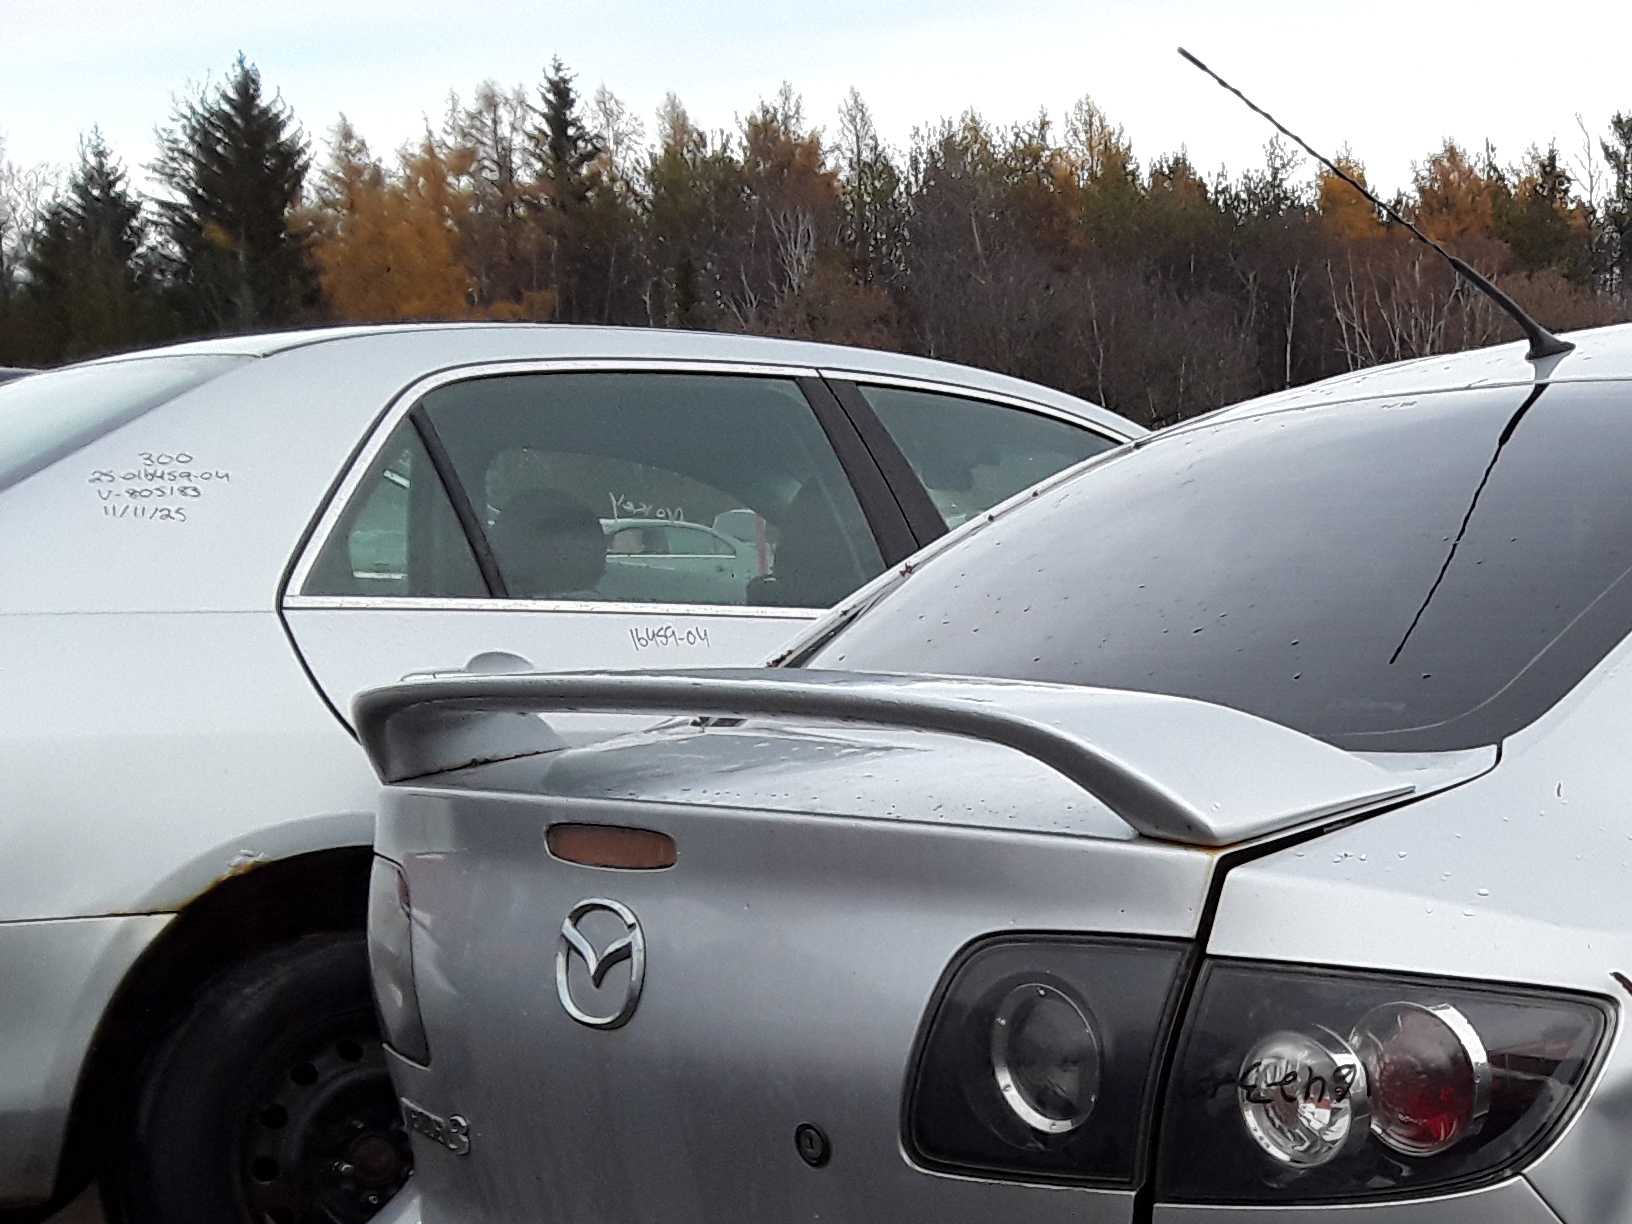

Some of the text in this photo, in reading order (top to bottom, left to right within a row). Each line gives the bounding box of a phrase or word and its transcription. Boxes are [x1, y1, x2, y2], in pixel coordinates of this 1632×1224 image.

[138, 452, 193, 467] 300
[103, 503, 187, 522] 11/11/25
[629, 625, 711, 651] 16459-04
